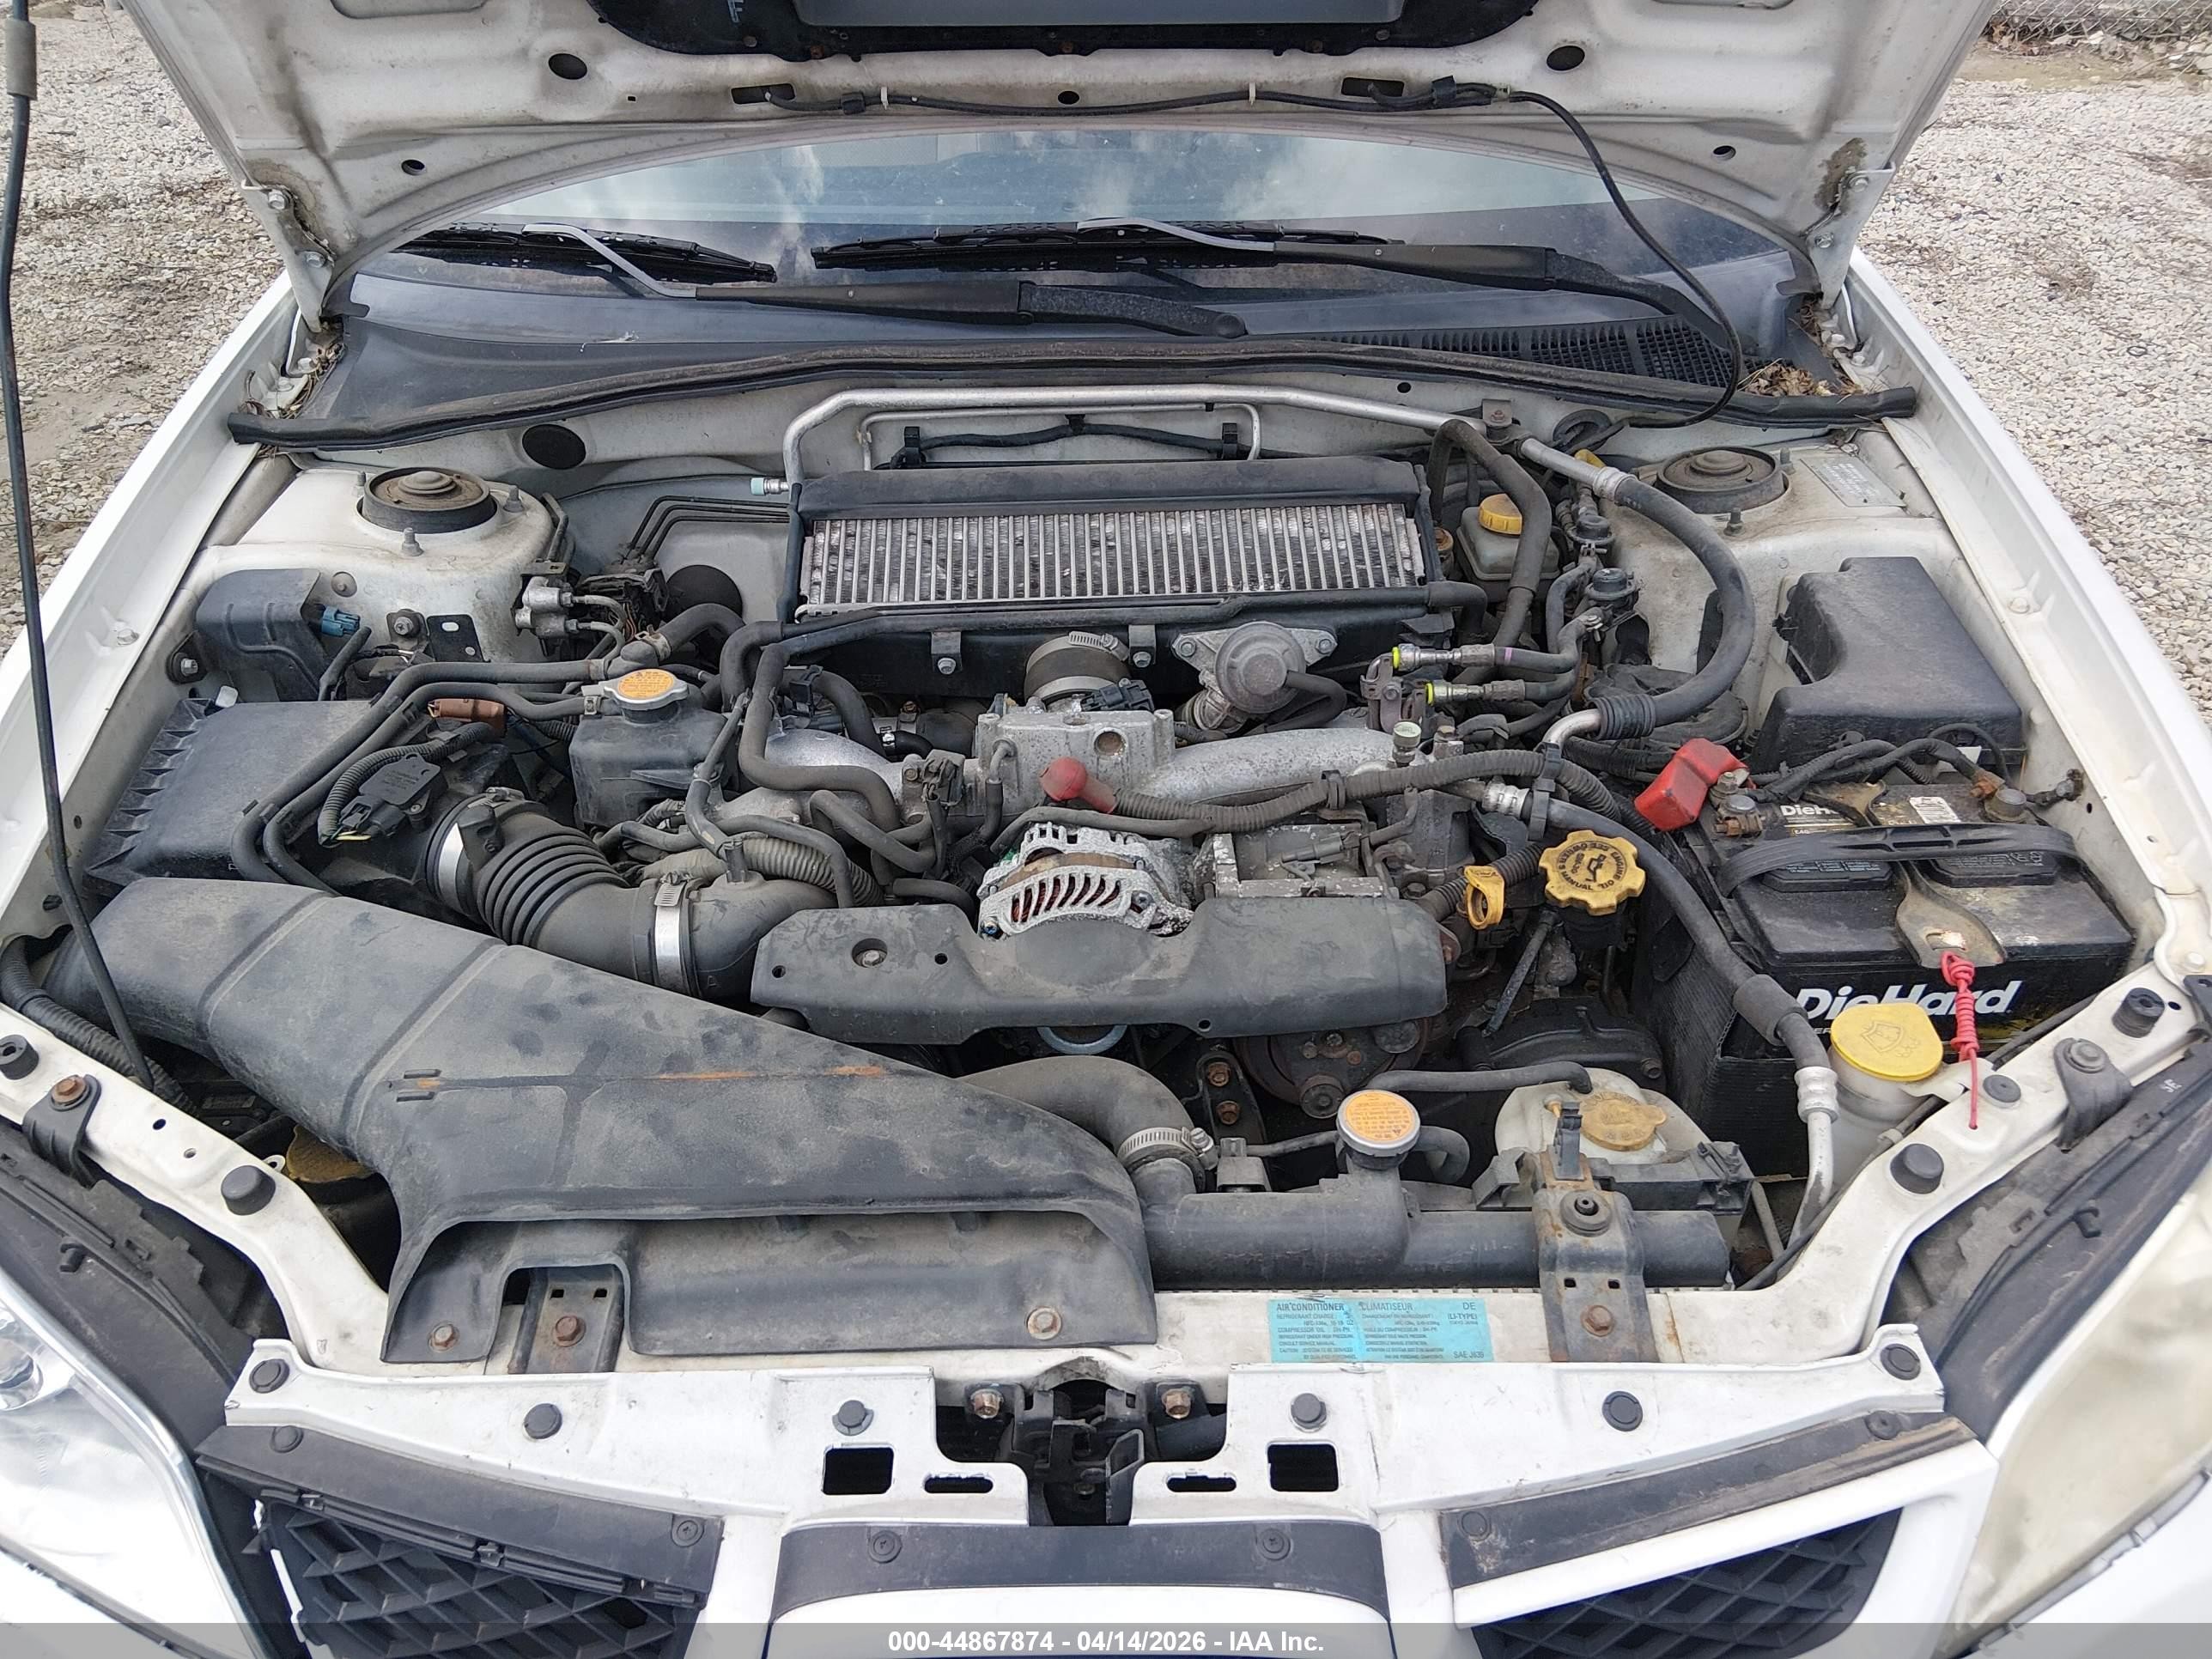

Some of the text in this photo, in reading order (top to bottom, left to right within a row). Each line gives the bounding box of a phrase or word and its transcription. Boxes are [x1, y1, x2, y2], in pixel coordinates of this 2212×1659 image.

[1598, 851, 1625, 889] ENGINE OIL
[1561, 871, 1594, 890] MANUAL
[1277, 1303, 1345, 1311] AIR CONDITIONER
